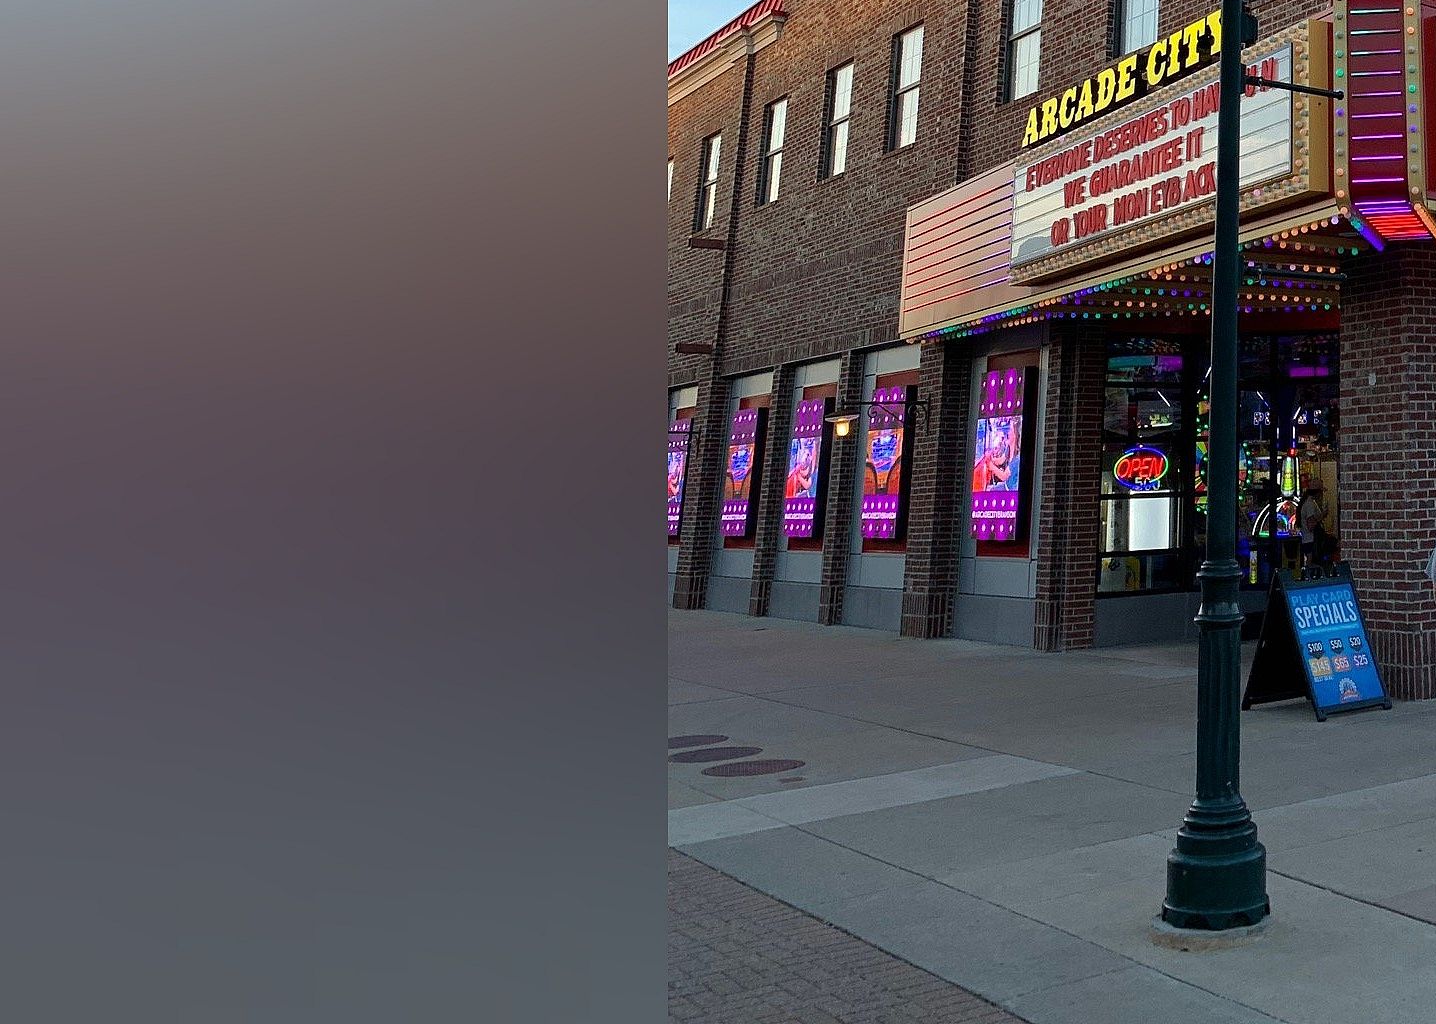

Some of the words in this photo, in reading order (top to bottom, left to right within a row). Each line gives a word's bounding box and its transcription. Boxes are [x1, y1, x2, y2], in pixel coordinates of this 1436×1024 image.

[1022, 55, 1137, 148] ARCADE
[1146, 9, 1222, 87] CITY
[1025, 139, 1092, 193] EVERYONE
[1092, 106, 1168, 164] DESERVES
[1168, 96, 1191, 129] TO
[1191, 81, 1220, 121] HAV
[1063, 176, 1087, 209] WE
[1089, 135, 1183, 198] GUARANTEE
[1185, 126, 1203, 162] IT
[1051, 217, 1069, 247] OR
[1073, 203, 1108, 239] YOUR
[1117, 457, 1165, 479] OPEN
[1291, 592, 1320, 607] PLAY
[1321, 589, 1352, 603] CARD
[1294, 600, 1358, 628] SPECIALS
[1308, 642, 1323, 653] $100
[1330, 639, 1342, 649] $50
[1353, 654, 1368, 666] $25
